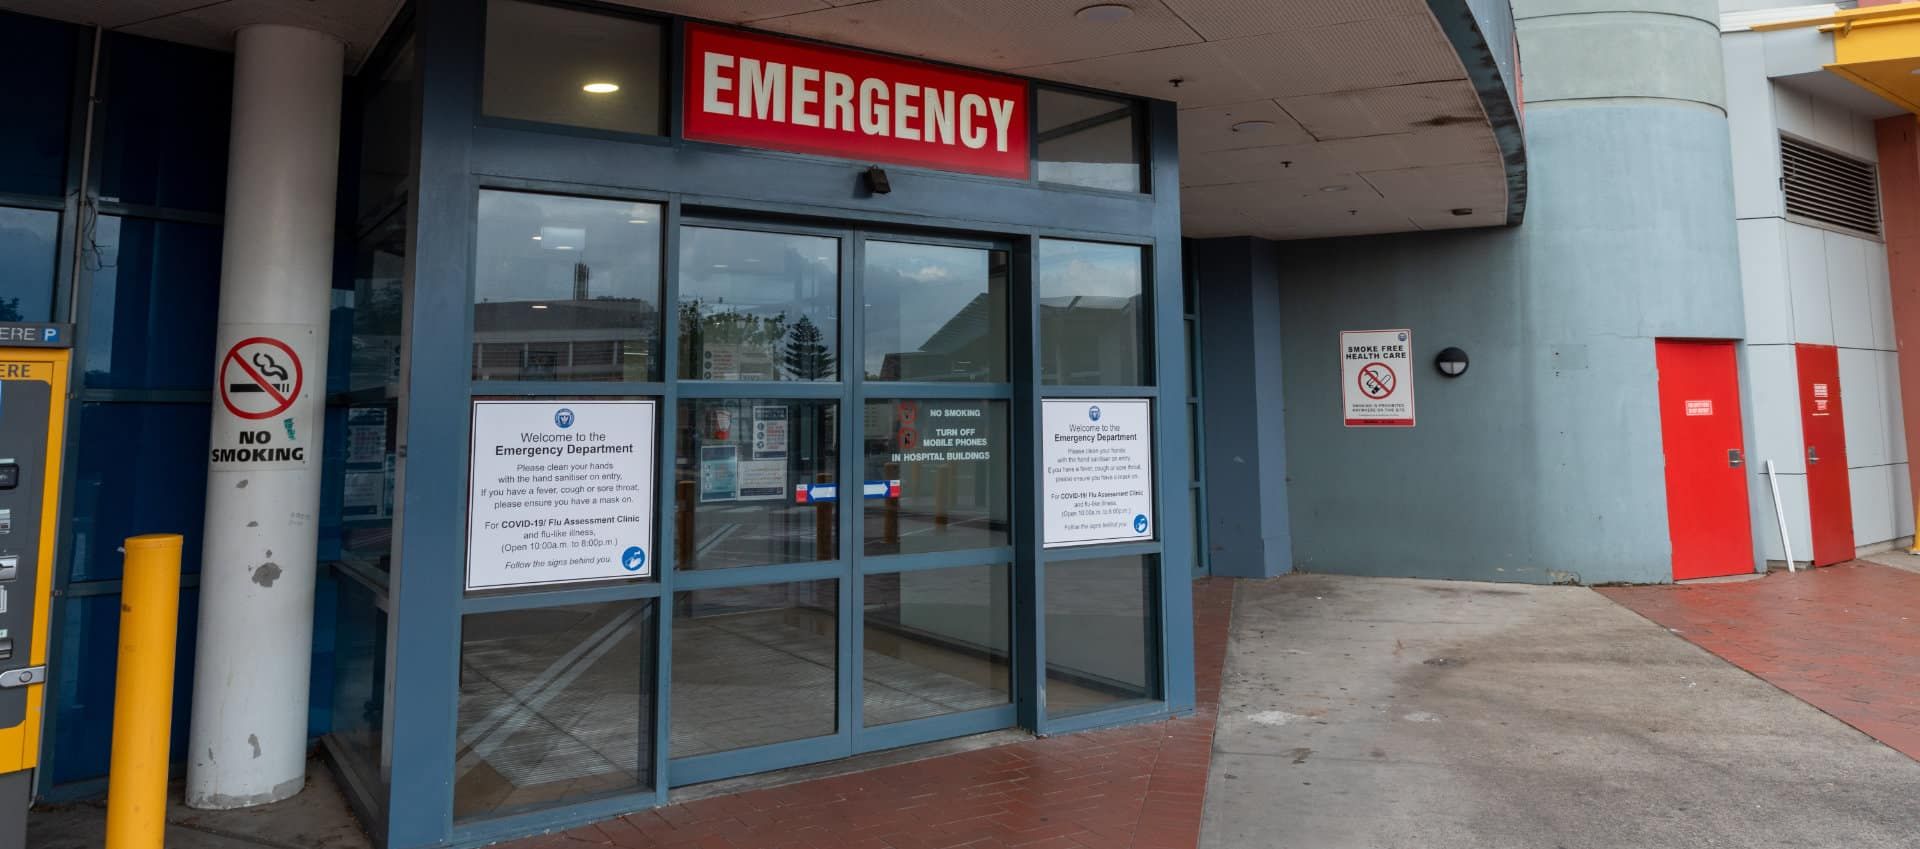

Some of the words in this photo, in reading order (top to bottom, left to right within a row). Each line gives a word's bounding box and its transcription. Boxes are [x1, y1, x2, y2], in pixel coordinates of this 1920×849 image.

[703, 51, 1015, 152] EMERGENCY
[929, 409, 943, 417] NO
[944, 409, 981, 417] SMOKING
[935, 428, 958, 437] TURN
[959, 428, 976, 437] OFF
[1068, 424, 1100, 432] Welcome
[239, 430, 271, 445] NO
[520, 432, 573, 443] Welcome
[576, 432, 587, 442] to
[589, 431, 606, 442] the
[923, 438, 953, 447] MOBILE
[955, 438, 988, 446] PHONES
[1054, 433, 1096, 443] Emergency
[1096, 432, 1137, 443] Department
[211, 447, 304, 463] SMOKING
[495, 445, 564, 457] Emergency
[567, 443, 634, 456] Department
[891, 453, 901, 462] IN
[903, 452, 945, 461] HOSPITAL
[946, 451, 991, 460] BUILDINGS
[516, 463, 545, 472] Please
[546, 462, 569, 471] clean
[570, 463, 588, 473] your
[589, 462, 614, 470] hands
[498, 475, 515, 483] with
[517, 475, 530, 483] the
[532, 474, 553, 482] hand
[554, 473, 588, 482] sanitiser
[589, 473, 600, 481] on
[481, 488, 487, 497] If
[488, 489, 504, 498] you
[506, 487, 527, 496] have
[560, 486, 585, 495] cough
[597, 485, 614, 493] sore
[494, 501, 522, 510] please
[523, 499, 553, 508] ensure
[554, 499, 569, 508] you
[570, 497, 590, 505] have
[599, 496, 620, 504] mask
[484, 521, 499, 531] For
[501, 518, 547, 529] COVID-19/
[548, 518, 562, 528] Flu
[563, 516, 615, 526] Assessment
[616, 515, 640, 524] Clinic
[523, 531, 539, 540] and
[541, 530, 567, 539] flu-like
[501, 542, 528, 553] (Open
[571, 539, 580, 549] to
[505, 560, 531, 570] Follow
[532, 559, 546, 568] the
[547, 557, 568, 568] signs
[569, 555, 595, 565] behind
